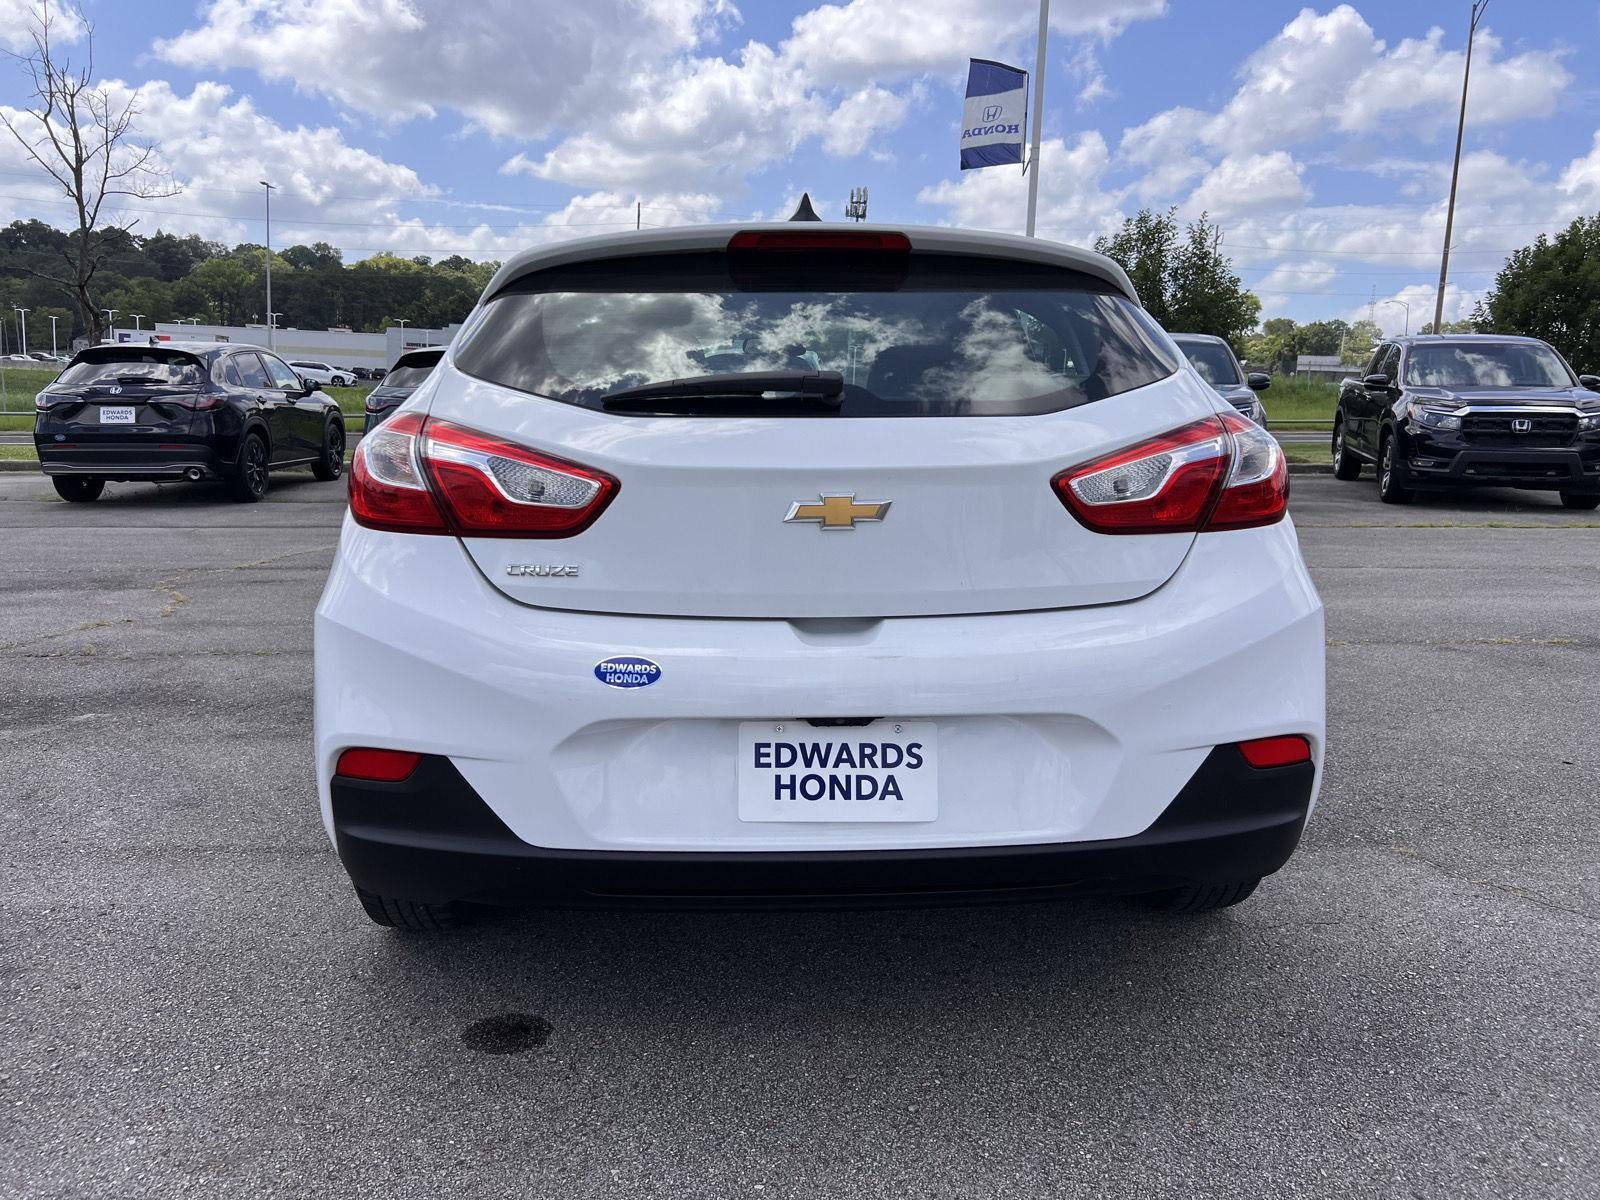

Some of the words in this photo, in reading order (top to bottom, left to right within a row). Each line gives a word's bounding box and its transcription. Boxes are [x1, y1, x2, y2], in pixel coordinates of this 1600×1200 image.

[506, 563, 579, 577] CRUZE
[600, 663, 657, 674] EDWARDS
[606, 674, 649, 684] HONDA
[754, 742, 924, 770] EDWARDS
[774, 774, 904, 801] HONDA
